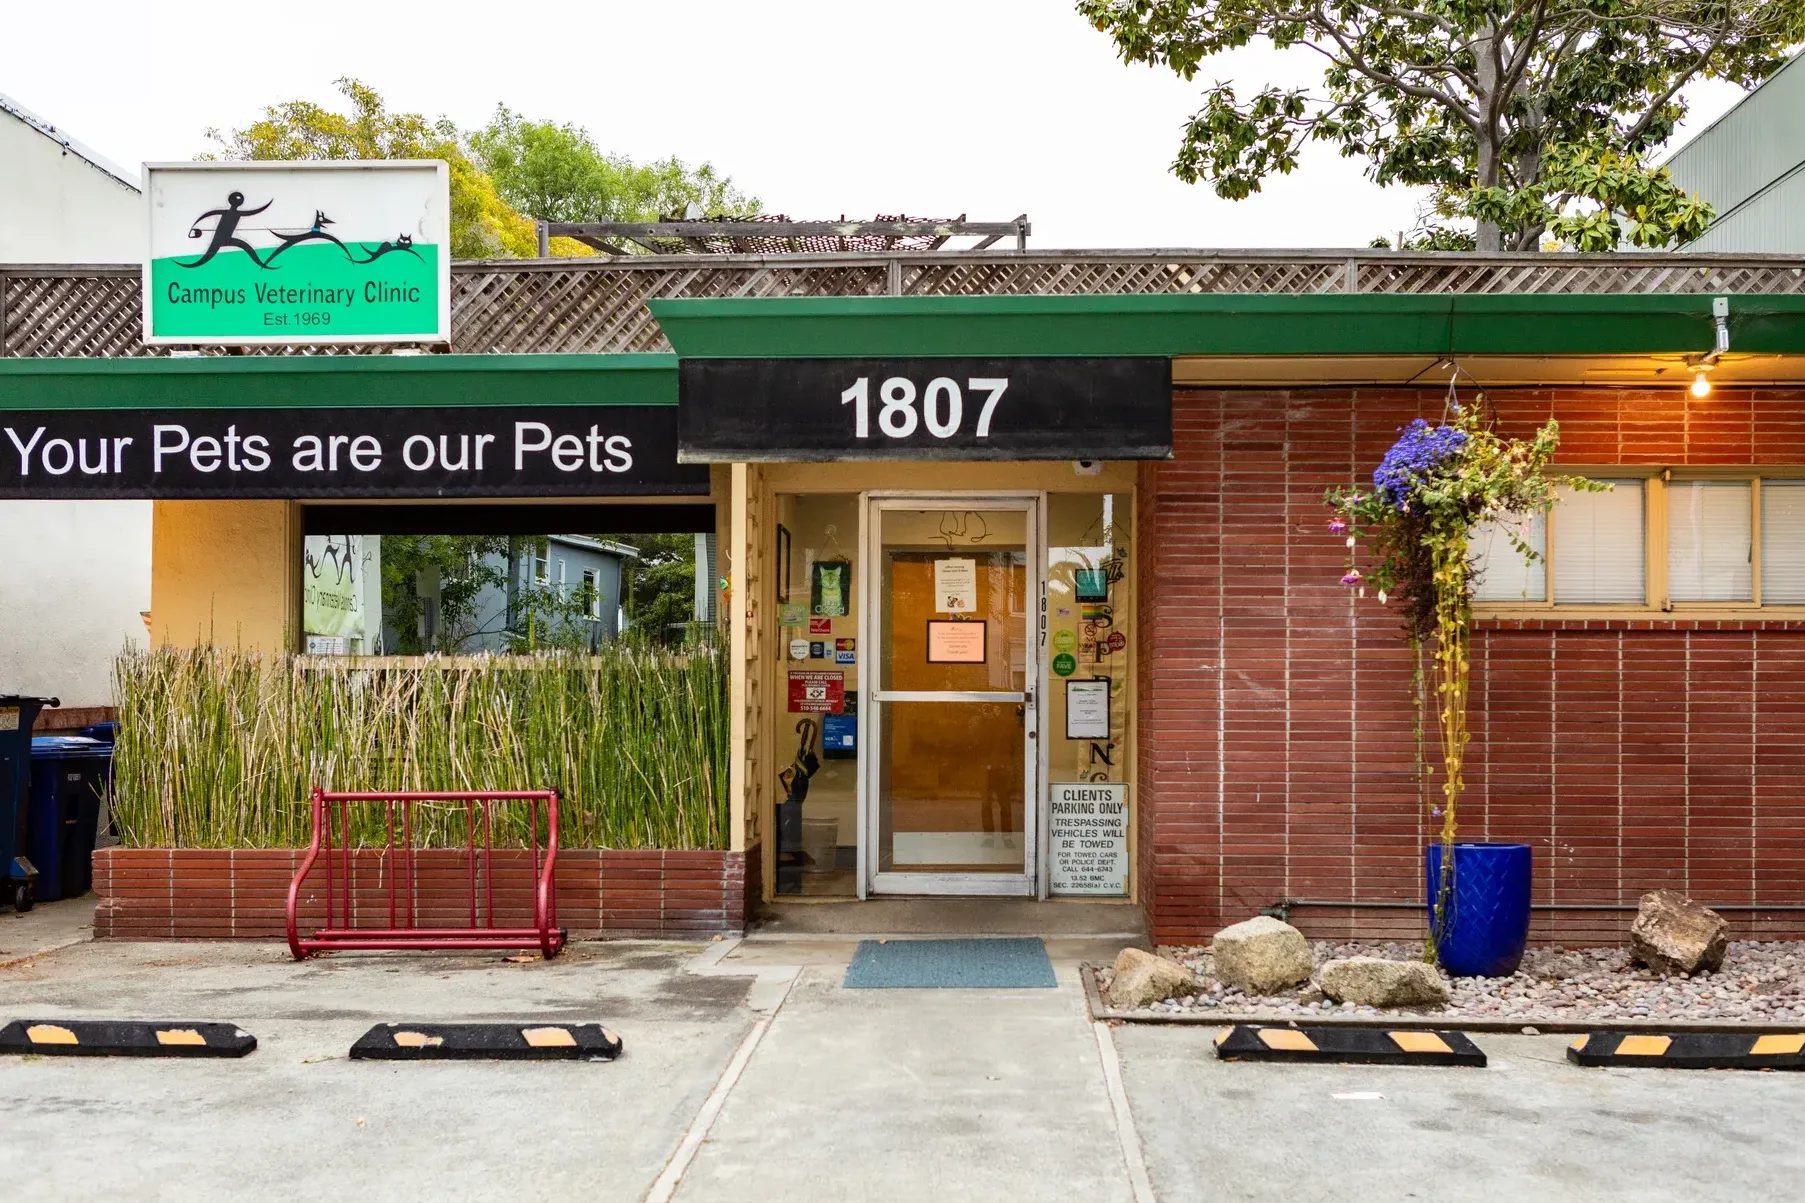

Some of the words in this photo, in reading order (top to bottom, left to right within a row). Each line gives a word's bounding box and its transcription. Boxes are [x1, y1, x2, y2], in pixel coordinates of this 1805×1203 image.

[167, 281, 246, 310] Campus
[254, 281, 356, 308] Veterinary
[363, 280, 421, 304] Clinic
[840, 376, 1009, 439] 1807
[3, 425, 134, 476] Your
[153, 423, 272, 473] Pets
[291, 434, 383, 472] are
[402, 433, 496, 472] our
[514, 421, 634, 473] Pets
[1063, 789, 1112, 801] CLIENTS
[1051, 803, 1095, 814] PARKING
[1099, 803, 1124, 814] ONLY
[1055, 819, 1122, 827] TRESPASSING
[1051, 829, 1098, 838] VEHICLES
[1102, 829, 1125, 838] WILL
[1062, 840, 1075, 848] BE
[1080, 840, 1114, 848] TOWED
